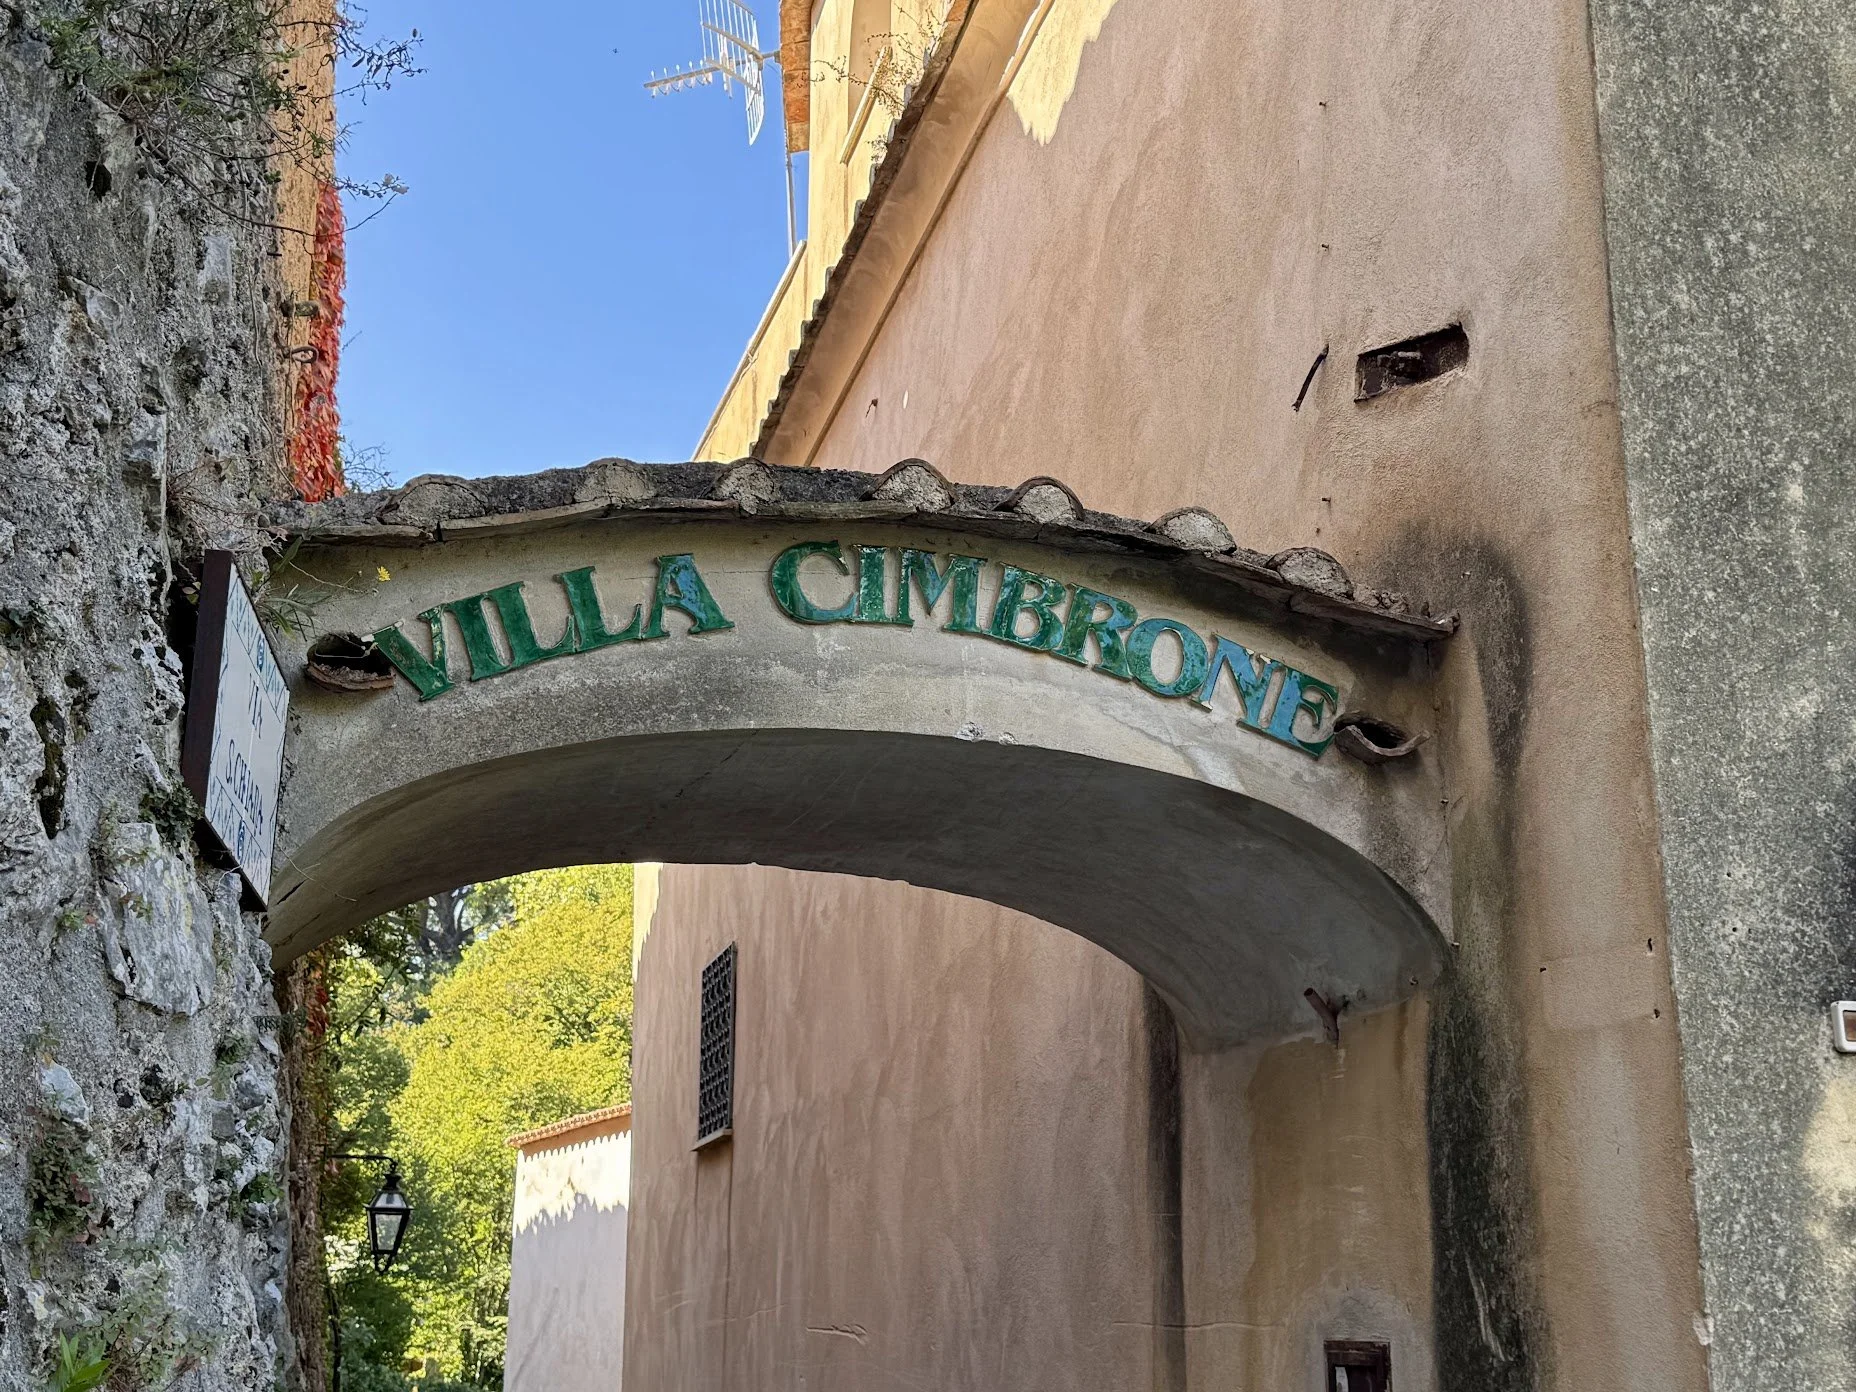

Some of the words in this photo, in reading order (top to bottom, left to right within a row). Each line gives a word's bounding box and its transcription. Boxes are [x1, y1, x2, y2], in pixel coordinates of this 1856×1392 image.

[248, 673, 263, 739] VIA
[365, 553, 735, 702] VILLA
[770, 541, 1339, 758] CIMBRONE
